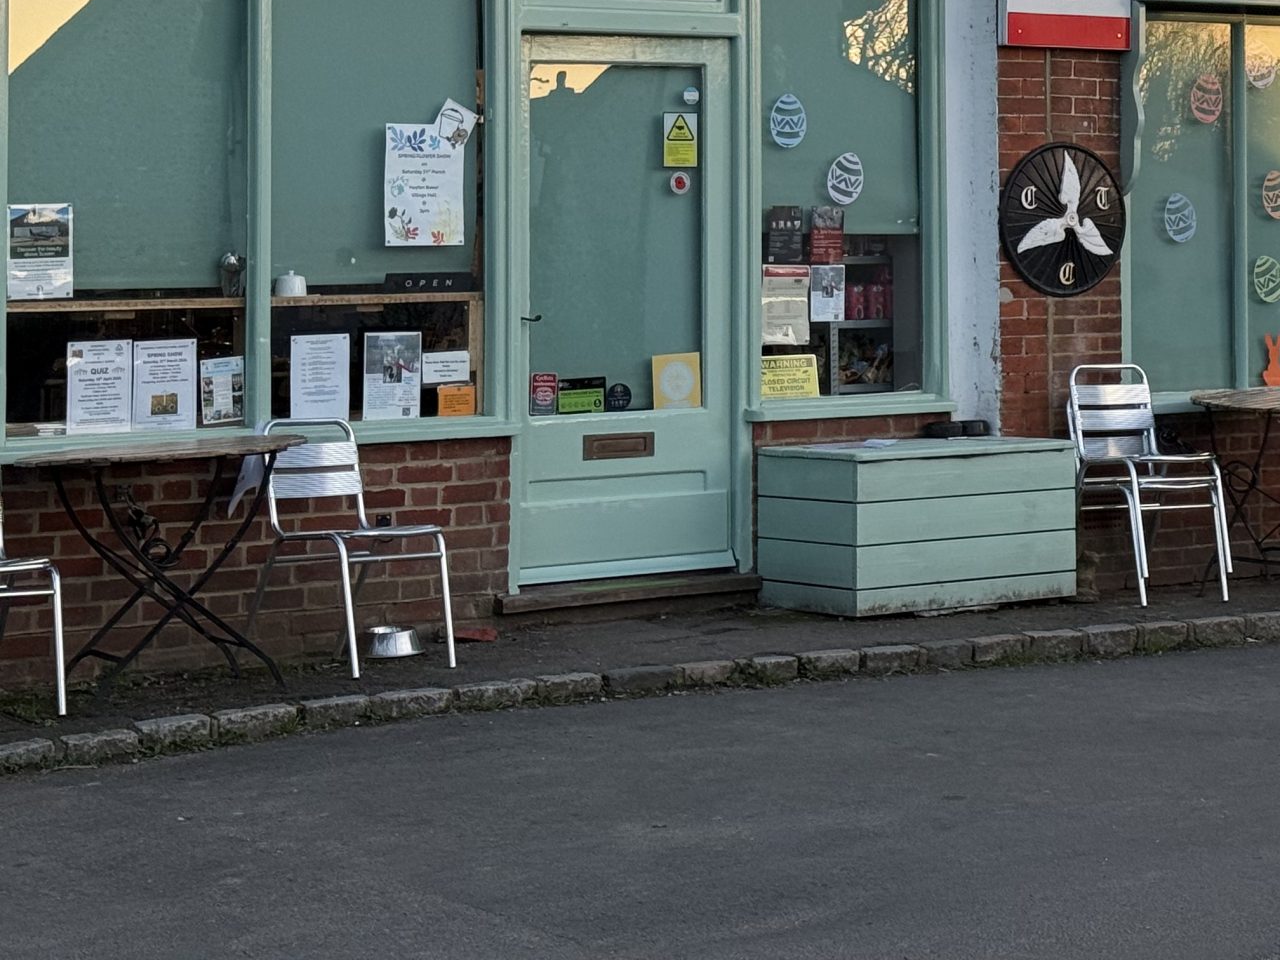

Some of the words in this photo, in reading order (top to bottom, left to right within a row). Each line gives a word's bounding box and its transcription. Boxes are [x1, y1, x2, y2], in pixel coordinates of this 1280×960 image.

[405, 279, 453, 287] OPEN
[761, 359, 806, 369] WARNING
[90, 367, 110, 375] QUIZ
